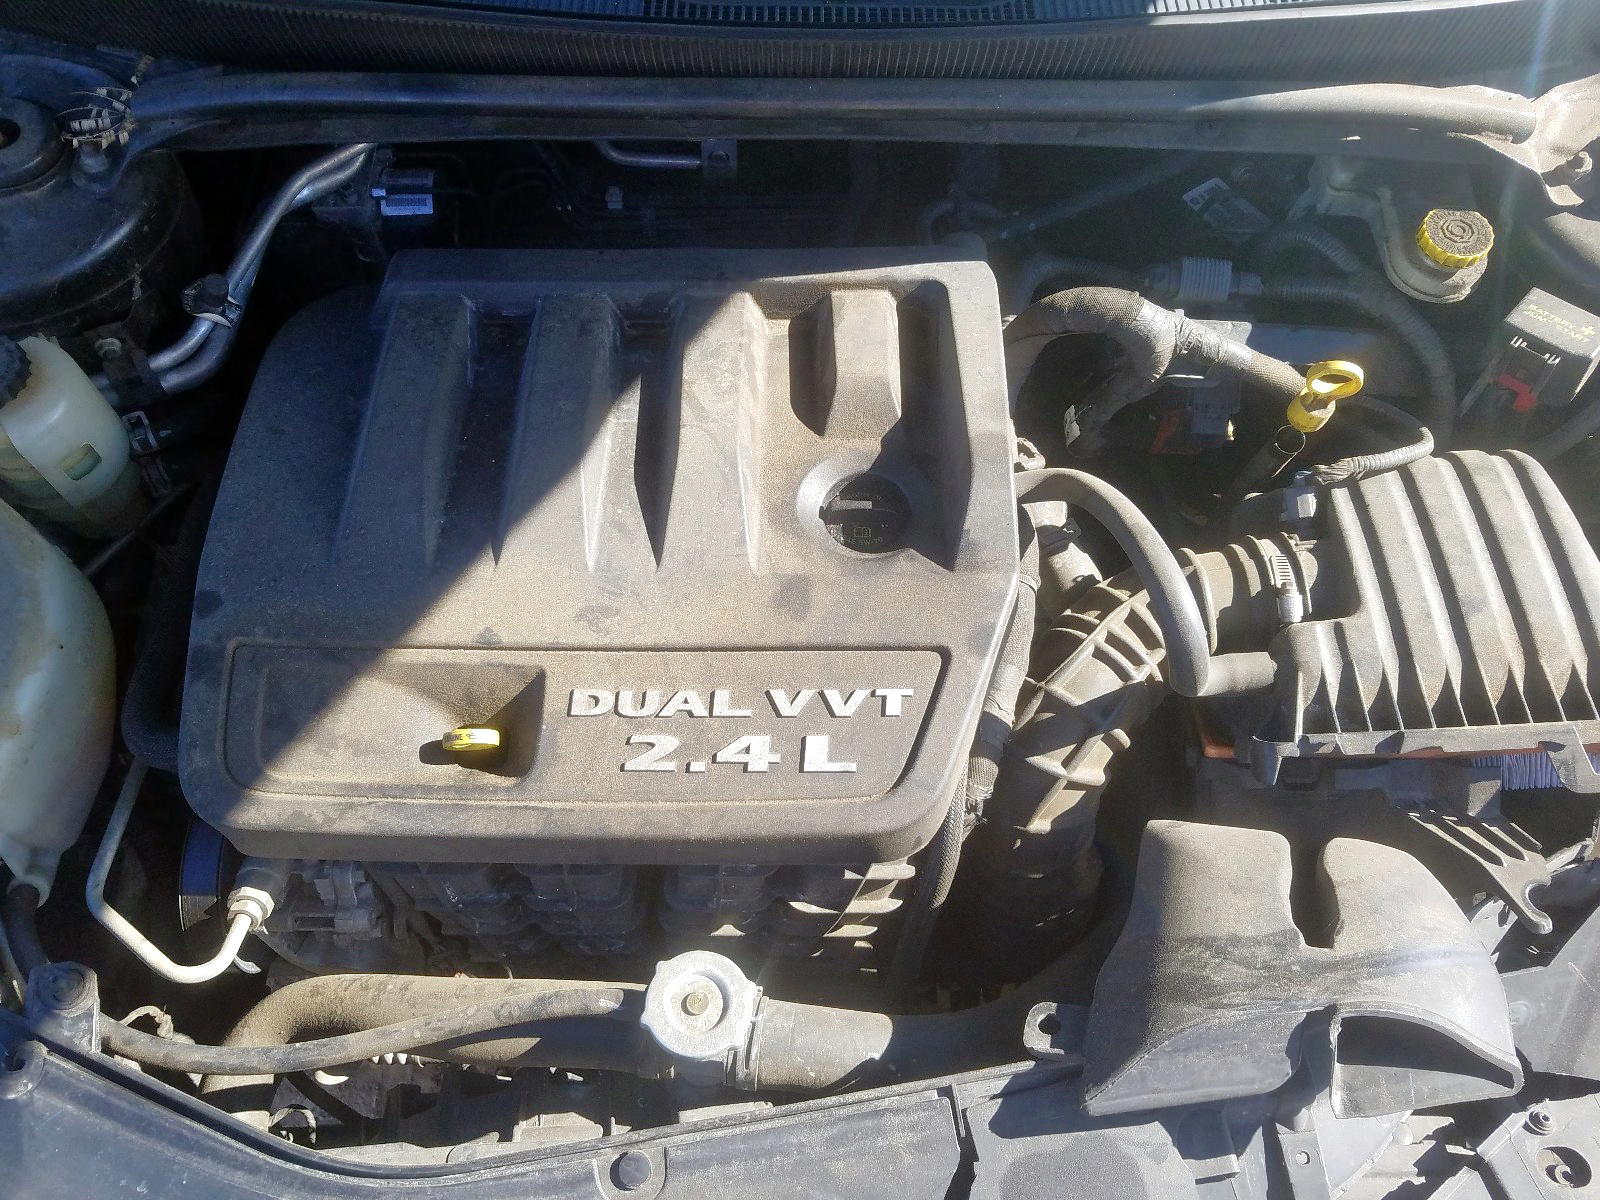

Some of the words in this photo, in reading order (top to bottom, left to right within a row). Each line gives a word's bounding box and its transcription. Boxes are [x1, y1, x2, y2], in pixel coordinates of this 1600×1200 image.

[1527, 304, 1577, 329] BATTERY
[567, 688, 752, 718] DUAL
[764, 688, 915, 718] VVT
[620, 734, 782, 773] 2.4
[800, 734, 858, 773] L
